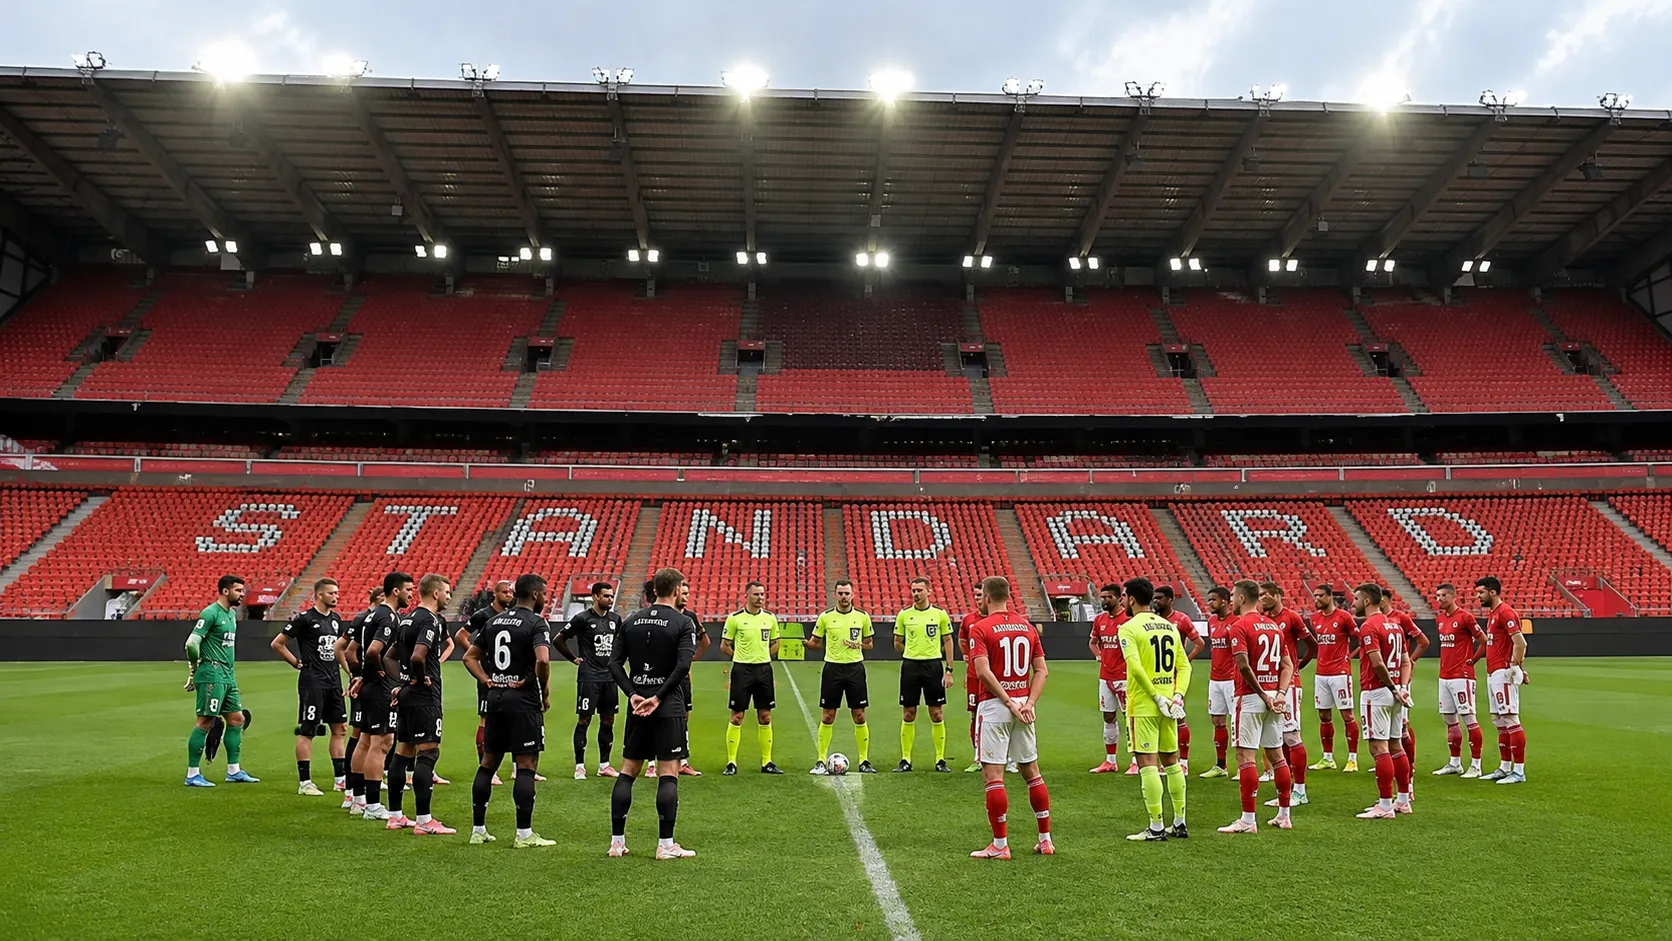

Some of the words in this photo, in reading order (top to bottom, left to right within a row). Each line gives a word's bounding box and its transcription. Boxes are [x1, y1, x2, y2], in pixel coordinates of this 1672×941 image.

[195, 503, 1494, 560] STANDARD
[494, 630, 512, 671] 6
[999, 636, 1031, 677] 10
[1149, 635, 1175, 673] 16
[1256, 633, 1282, 671] 24
[307, 705, 316, 721] 8
